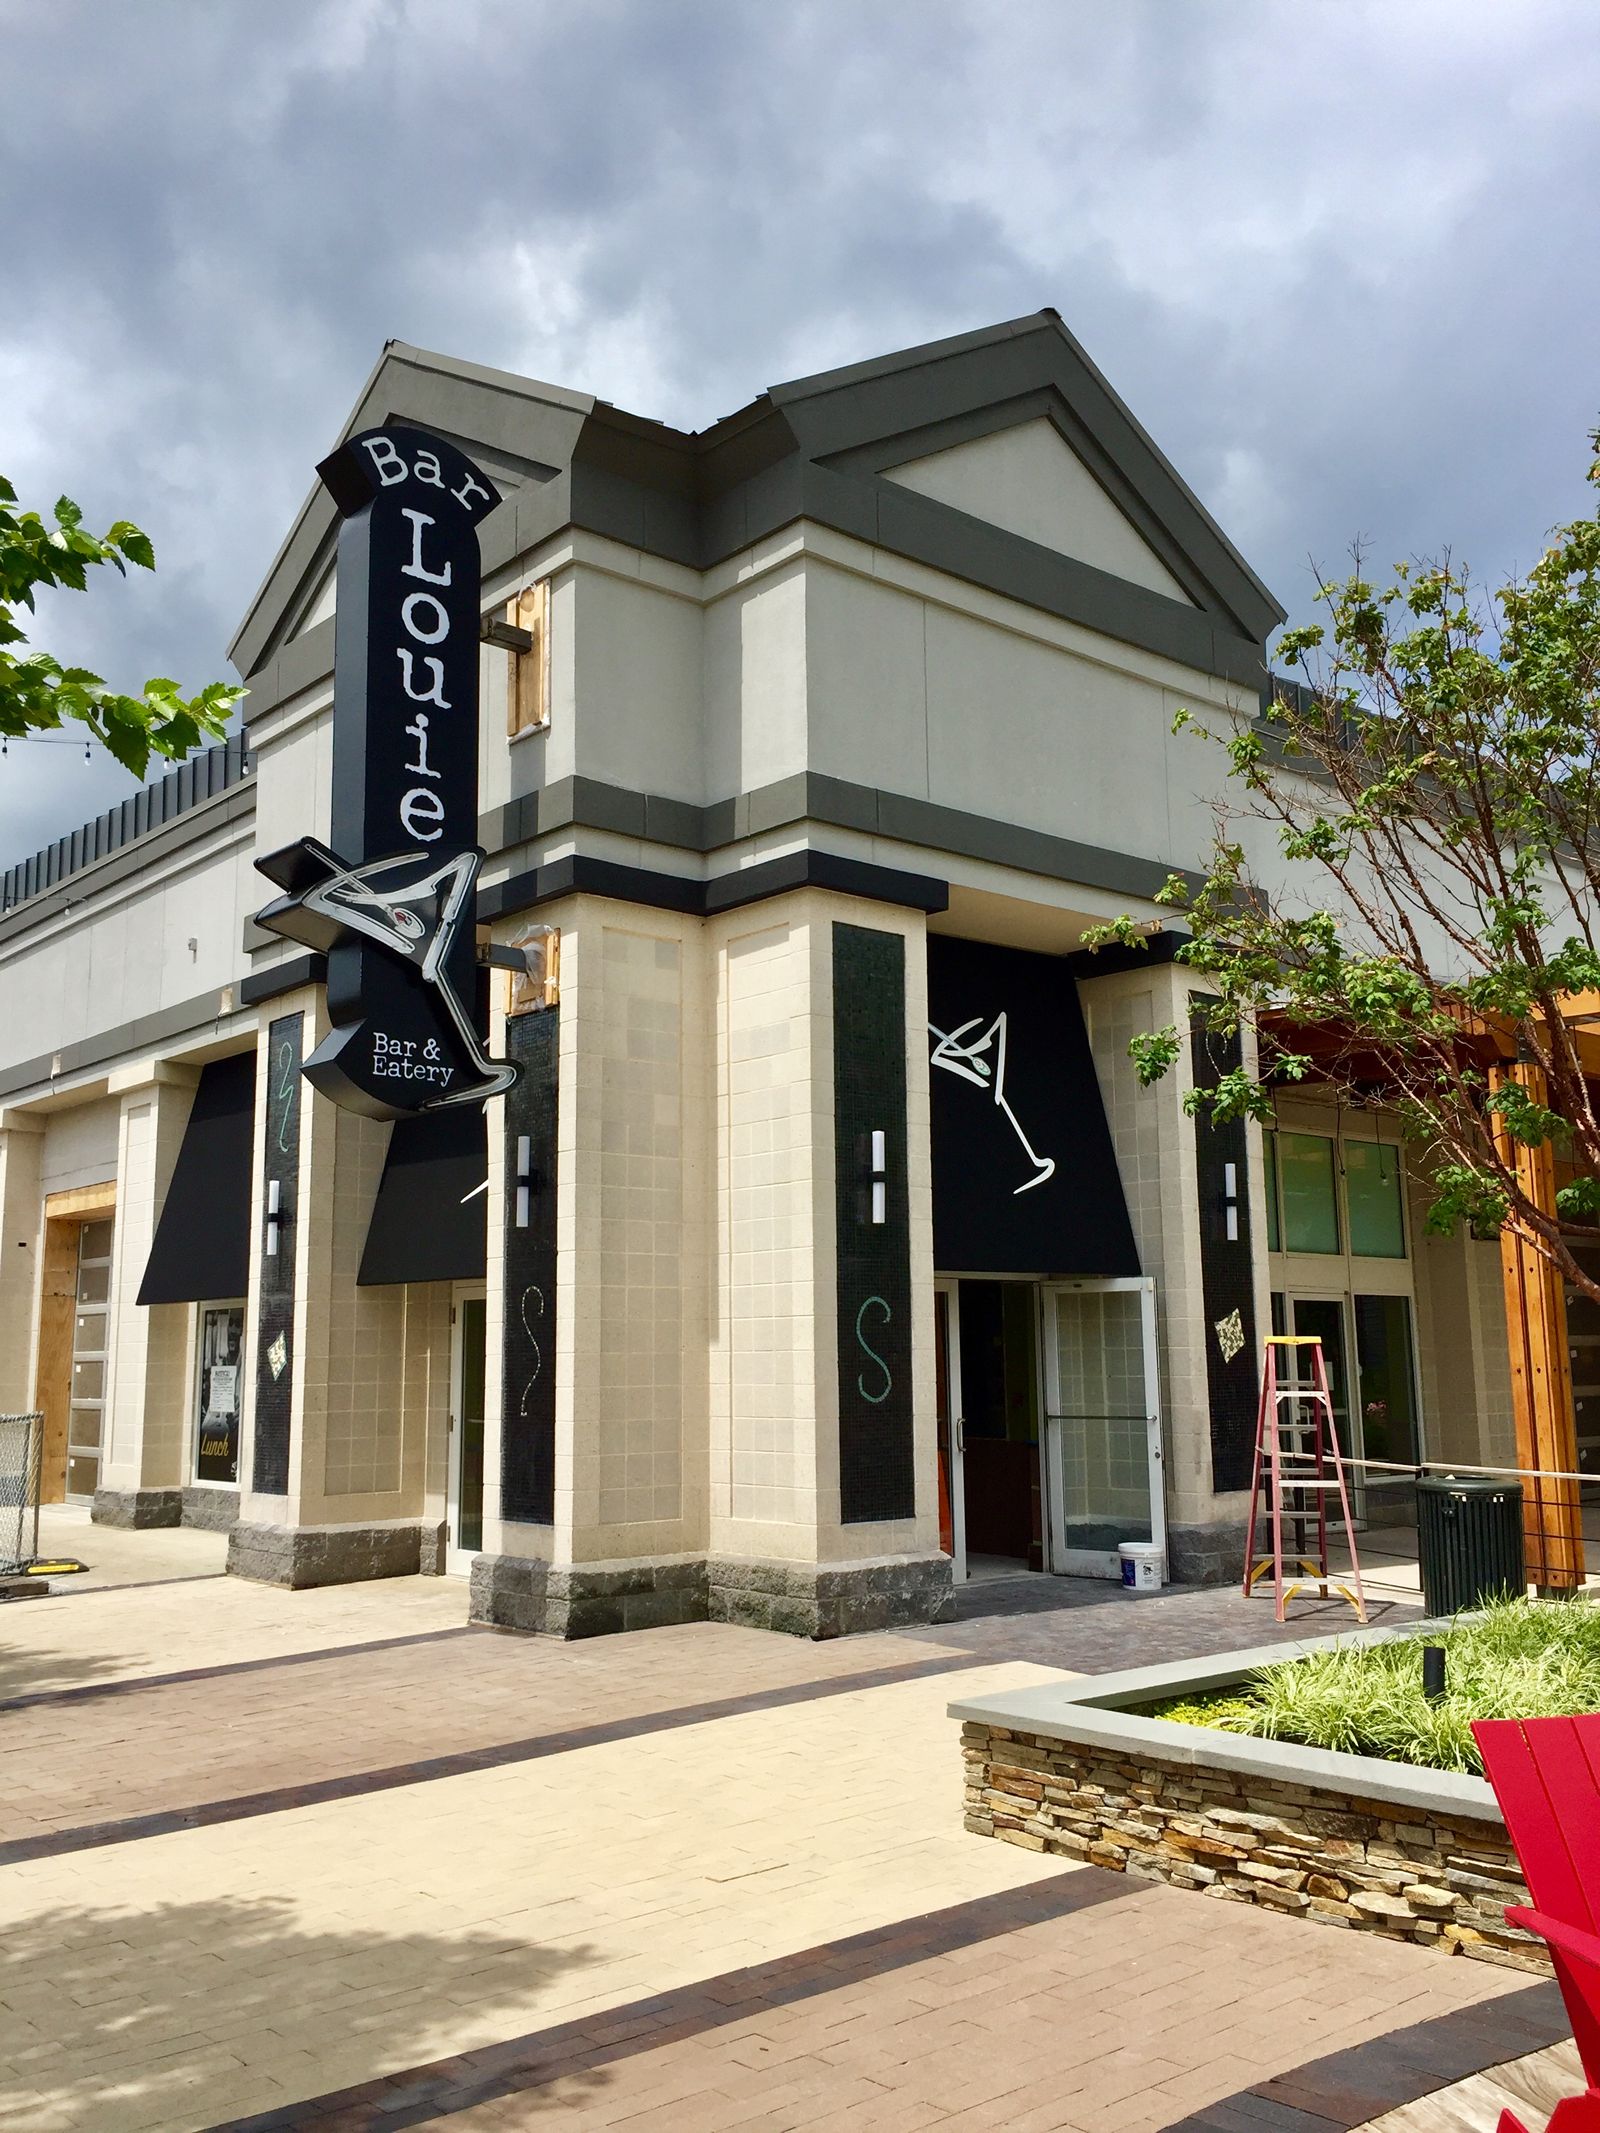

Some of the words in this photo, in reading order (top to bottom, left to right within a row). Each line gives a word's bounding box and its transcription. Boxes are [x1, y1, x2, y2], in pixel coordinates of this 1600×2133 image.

[362, 436, 489, 511] Bar
[397, 508, 452, 842] Louie
[373, 1032, 417, 1056] Bar
[423, 1038, 441, 1061] &
[373, 1055, 454, 1087] Eatery
[201, 1432, 229, 1456] Lunch
